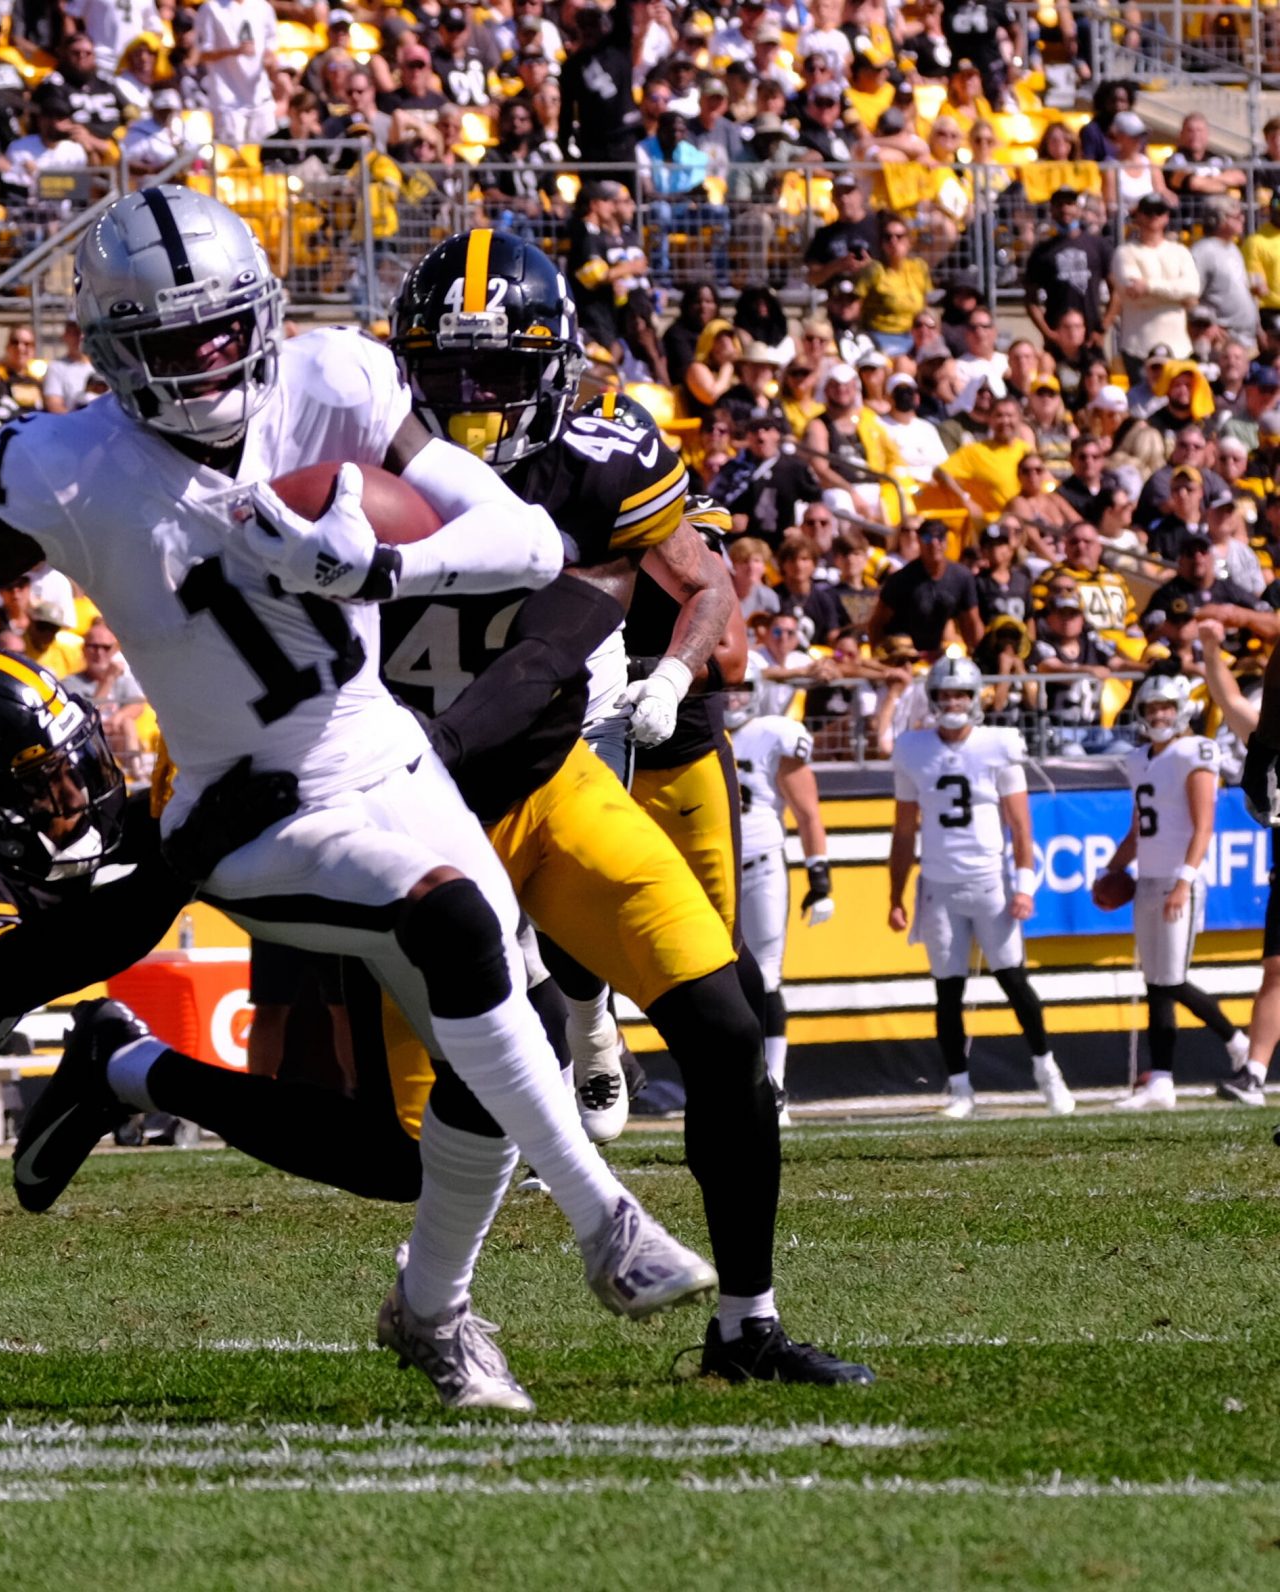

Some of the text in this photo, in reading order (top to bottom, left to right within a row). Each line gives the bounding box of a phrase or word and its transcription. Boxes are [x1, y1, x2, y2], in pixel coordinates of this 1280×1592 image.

[443, 277, 508, 313] 42
[563, 416, 648, 463] 42
[936, 774, 973, 828] 3
[1135, 783, 1158, 838] 6
